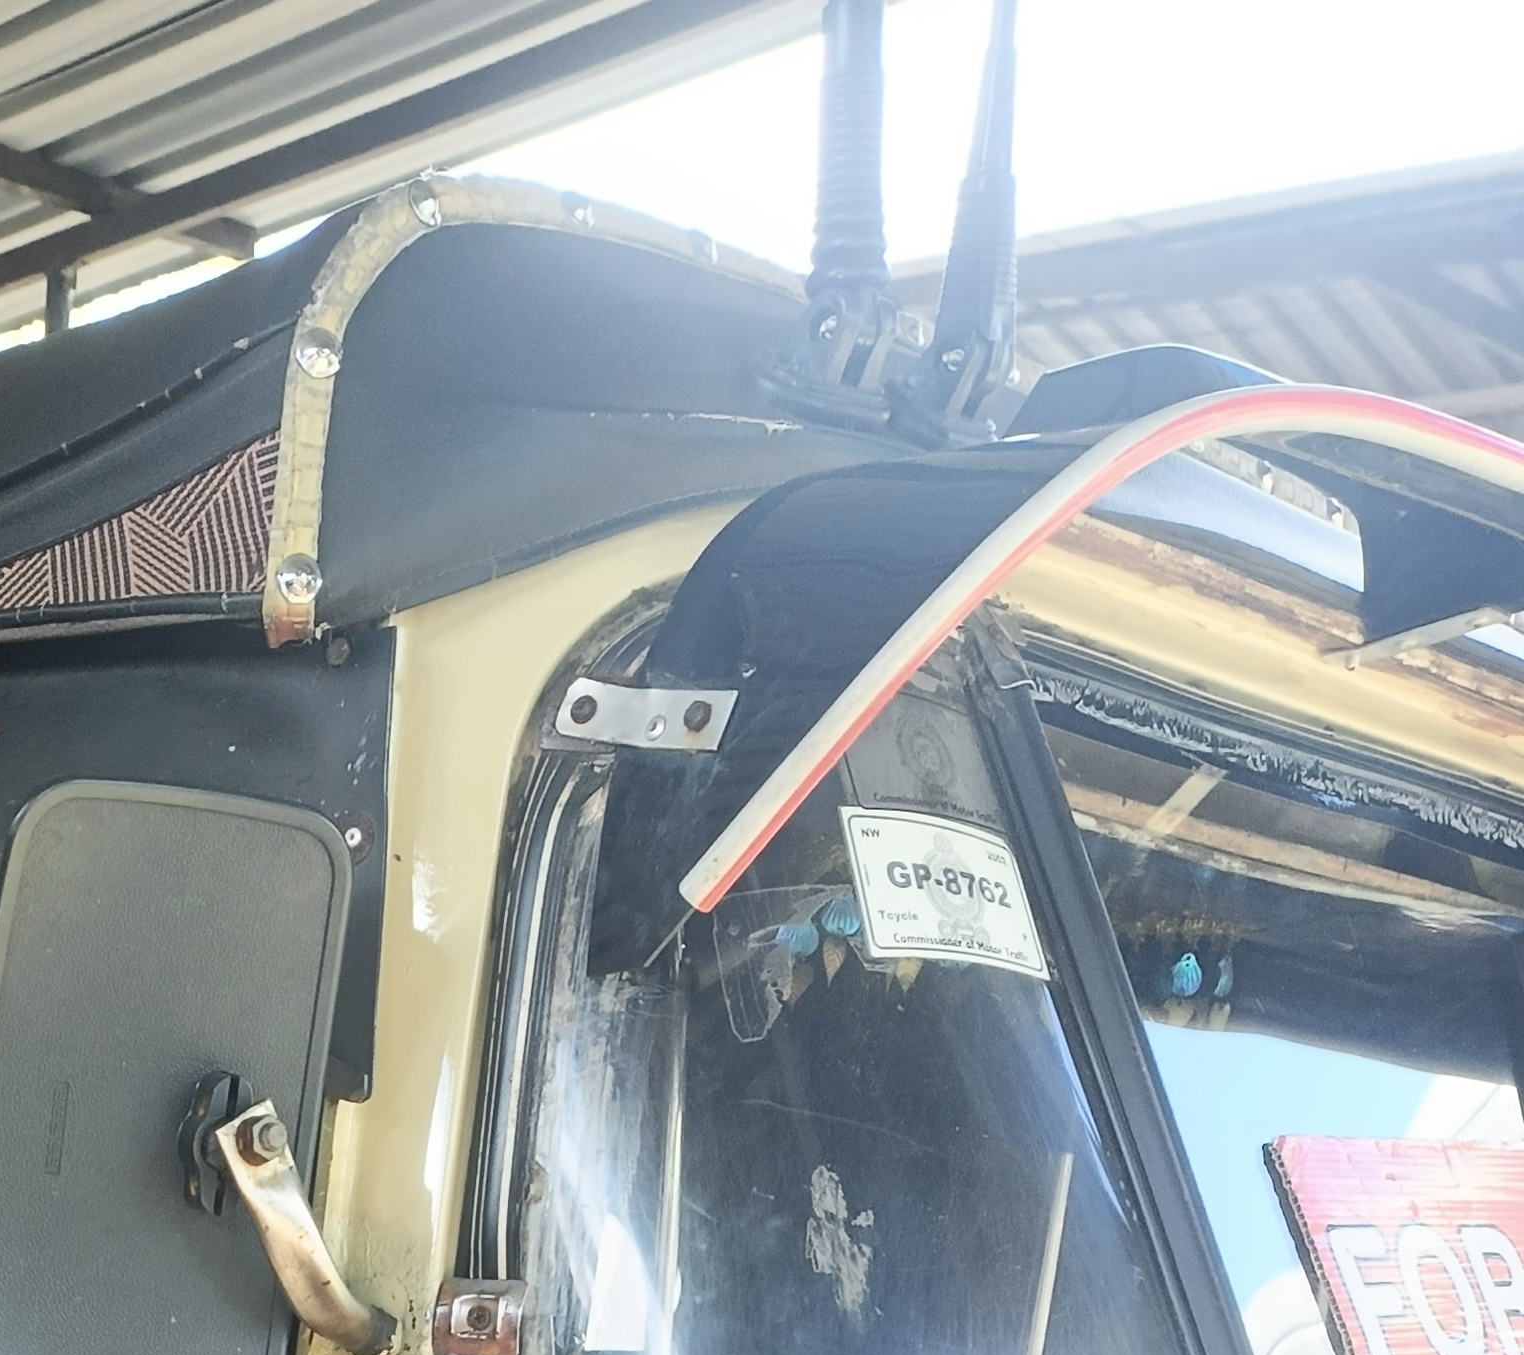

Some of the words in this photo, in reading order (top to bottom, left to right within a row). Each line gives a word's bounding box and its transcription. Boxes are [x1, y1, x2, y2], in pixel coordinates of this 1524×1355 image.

[861, 828, 880, 838] NW
[886, 861, 1012, 909] GP-8762
[878, 910, 919, 922] Tcycle
[893, 932, 962, 947] Commissioner
